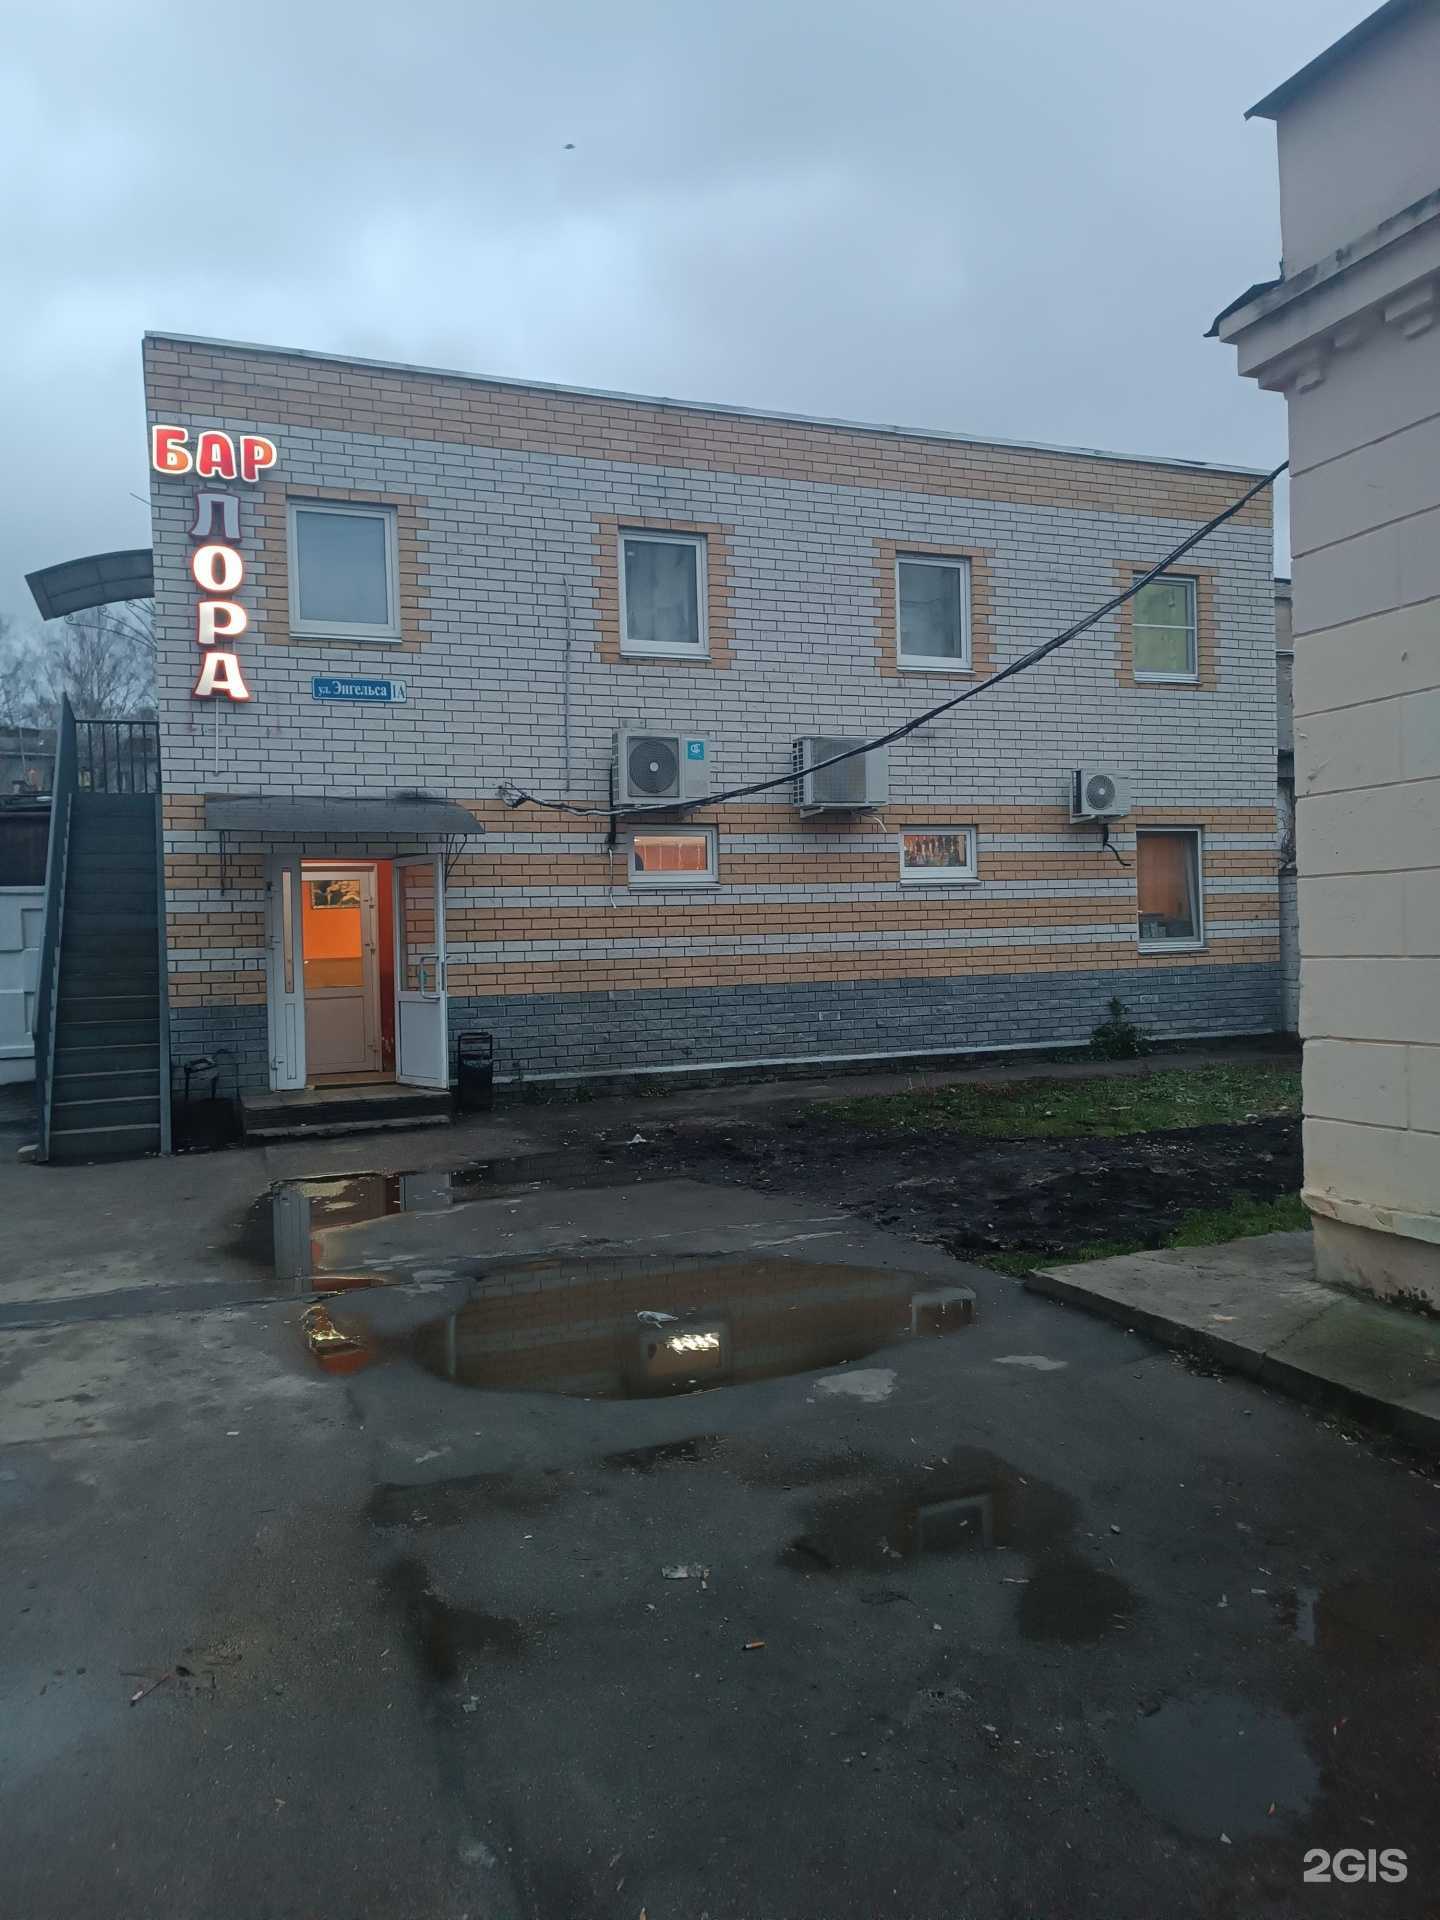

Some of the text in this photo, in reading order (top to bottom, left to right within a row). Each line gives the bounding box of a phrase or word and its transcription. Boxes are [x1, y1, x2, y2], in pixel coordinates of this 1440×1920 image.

[152, 424, 277, 482] БАР
[190, 492, 250, 701] ЛОРА
[317, 685, 331, 697] ул.
[332, 680, 388, 697] Энгельса
